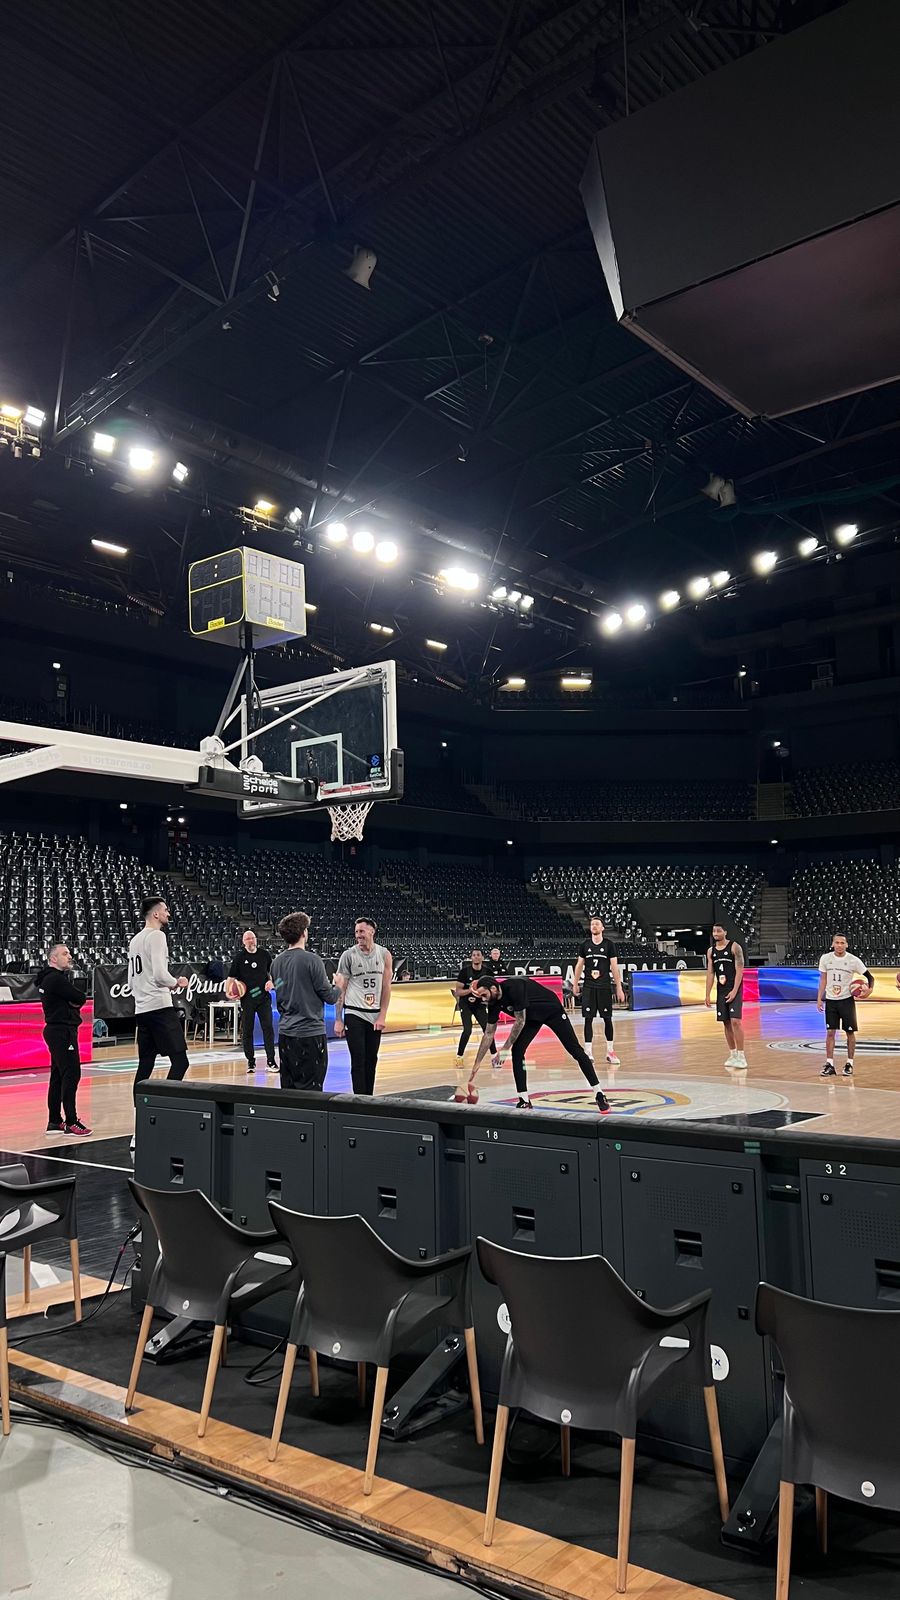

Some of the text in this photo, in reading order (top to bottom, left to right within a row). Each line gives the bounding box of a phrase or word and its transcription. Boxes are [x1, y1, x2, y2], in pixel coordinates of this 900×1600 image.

[243, 774, 279, 787] Schelde
[243, 782, 279, 795] Sports
[592, 959, 599, 967] 7
[832, 973, 842, 981] 11
[363, 978, 376, 988] 55
